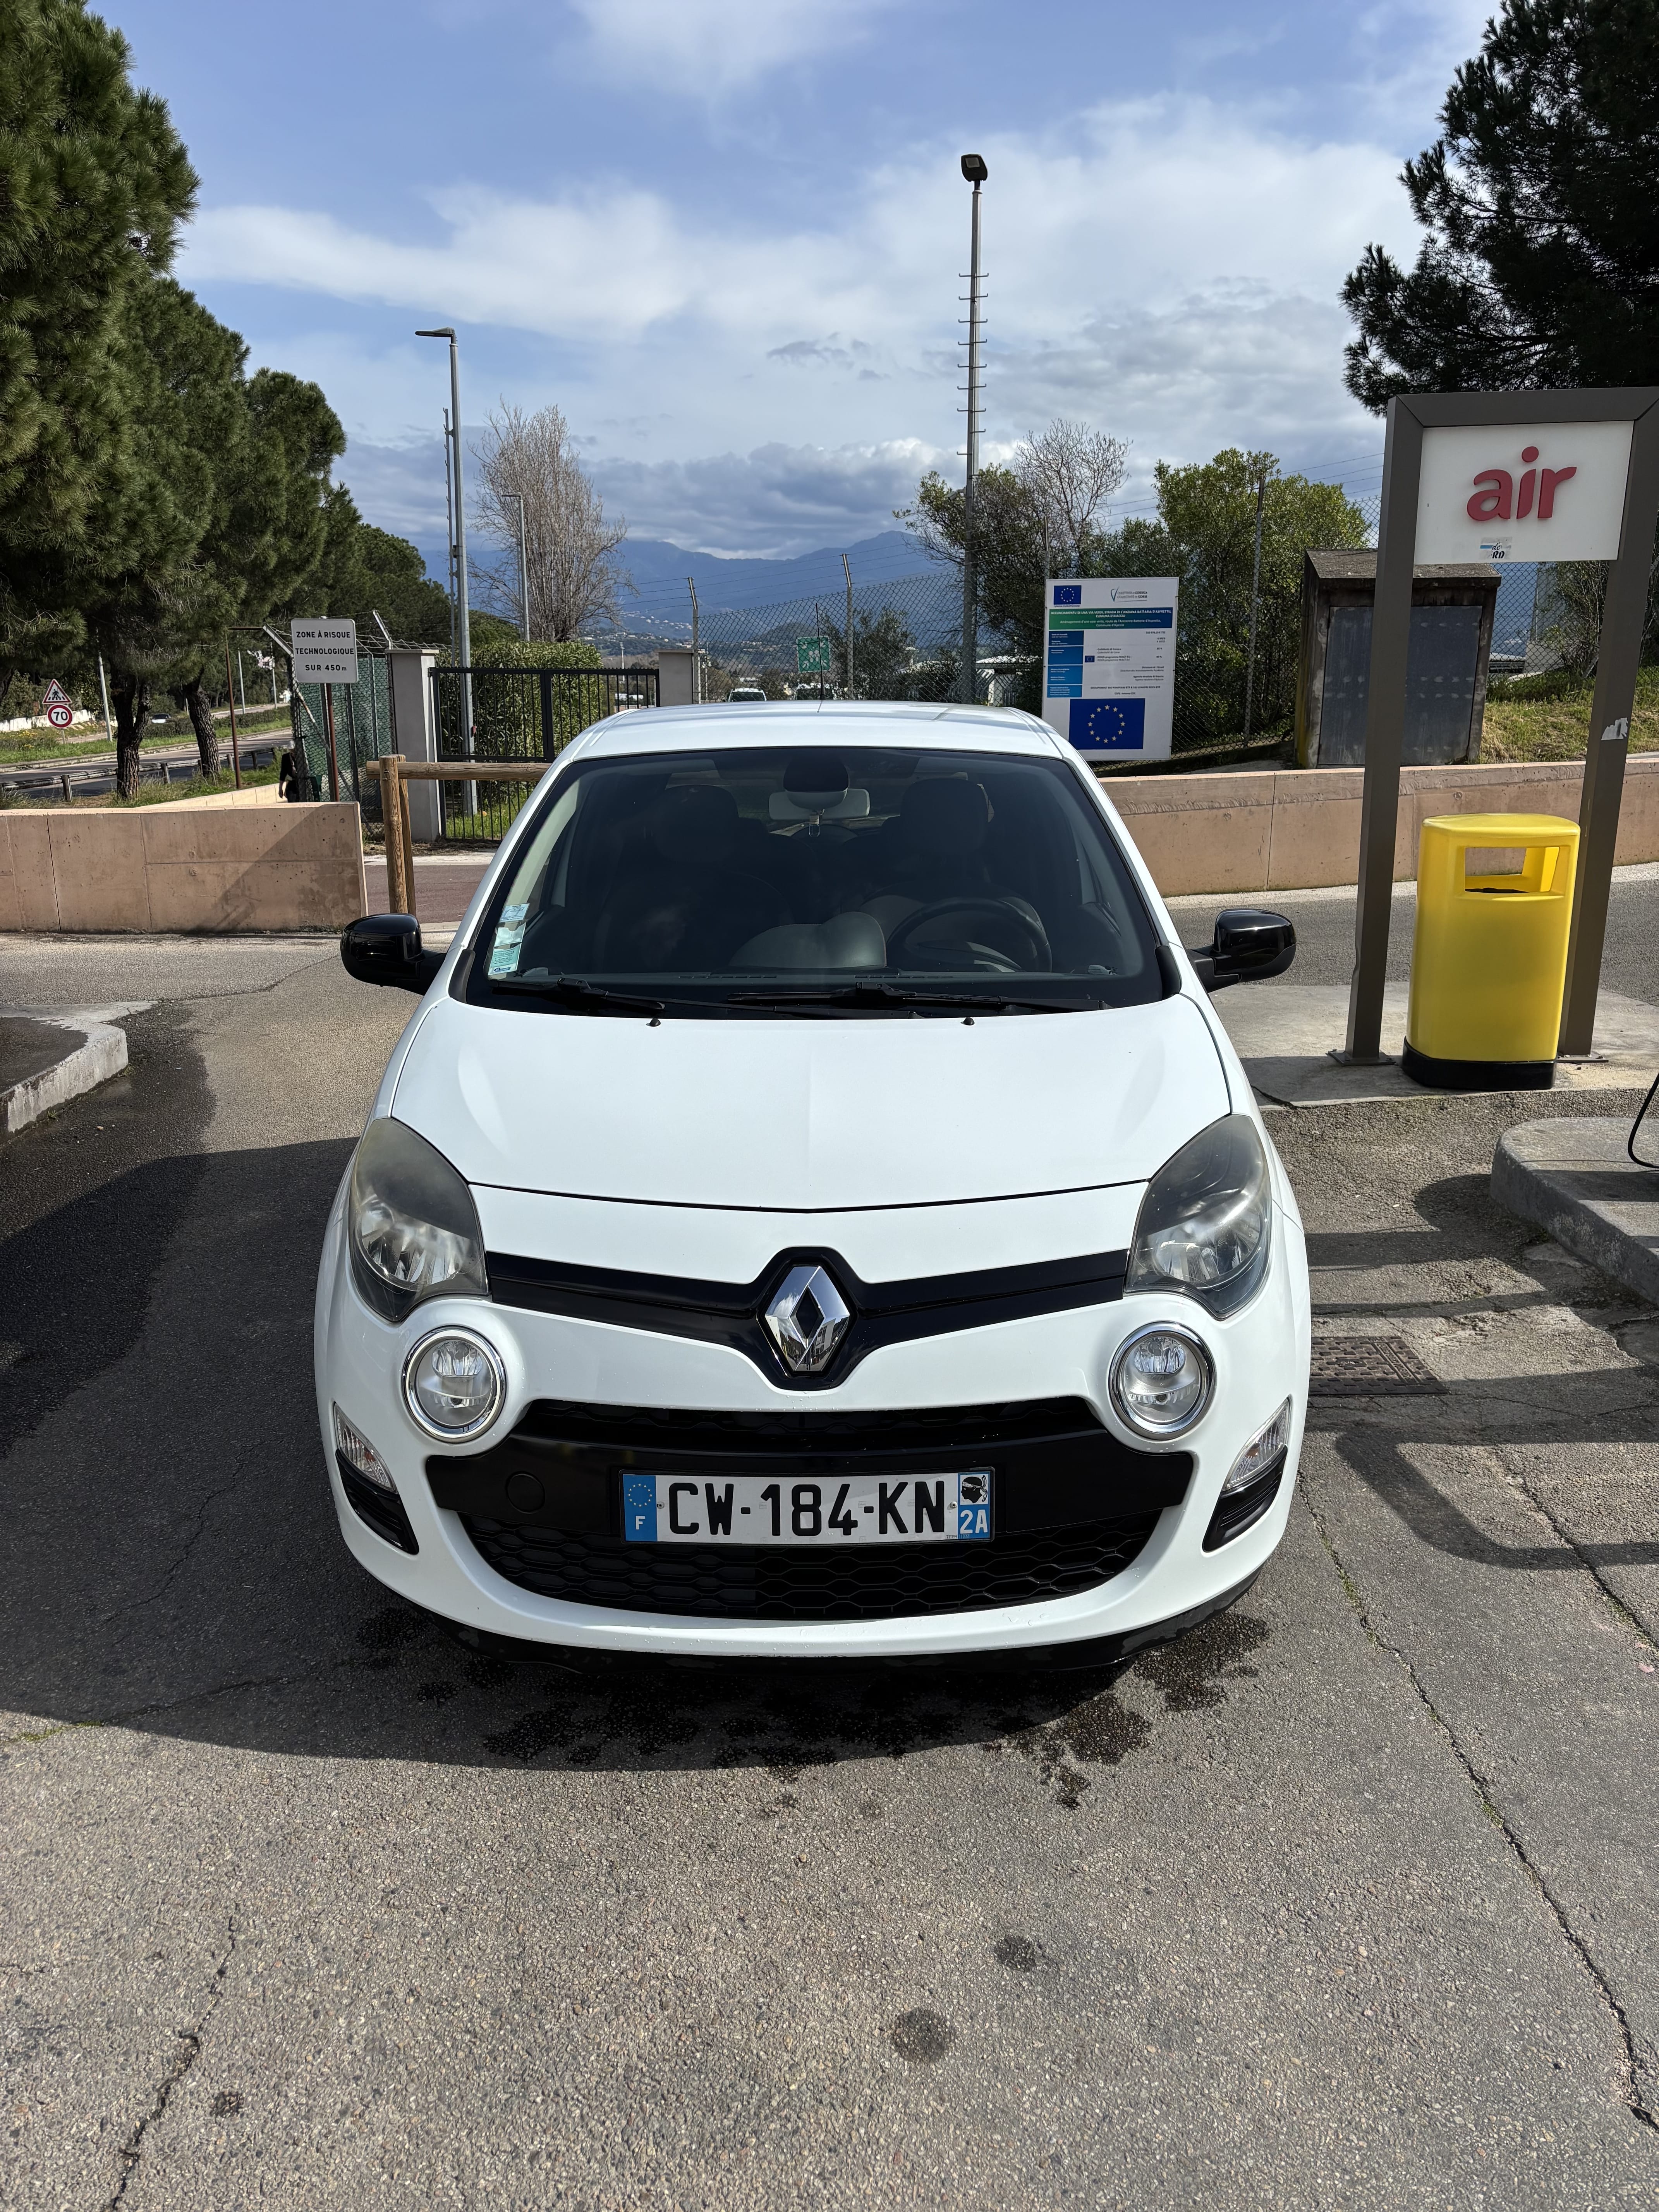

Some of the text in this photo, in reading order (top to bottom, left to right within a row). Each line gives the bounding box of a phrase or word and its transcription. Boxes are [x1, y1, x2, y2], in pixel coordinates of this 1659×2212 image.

[1467, 446, 1577, 521] air
[318, 630, 323, 638] À
[53, 711, 68, 721] 70
[668, 1480, 945, 1536] CW-184-KN
[635, 1515, 646, 1530] F
[960, 1509, 988, 1534] 2A
